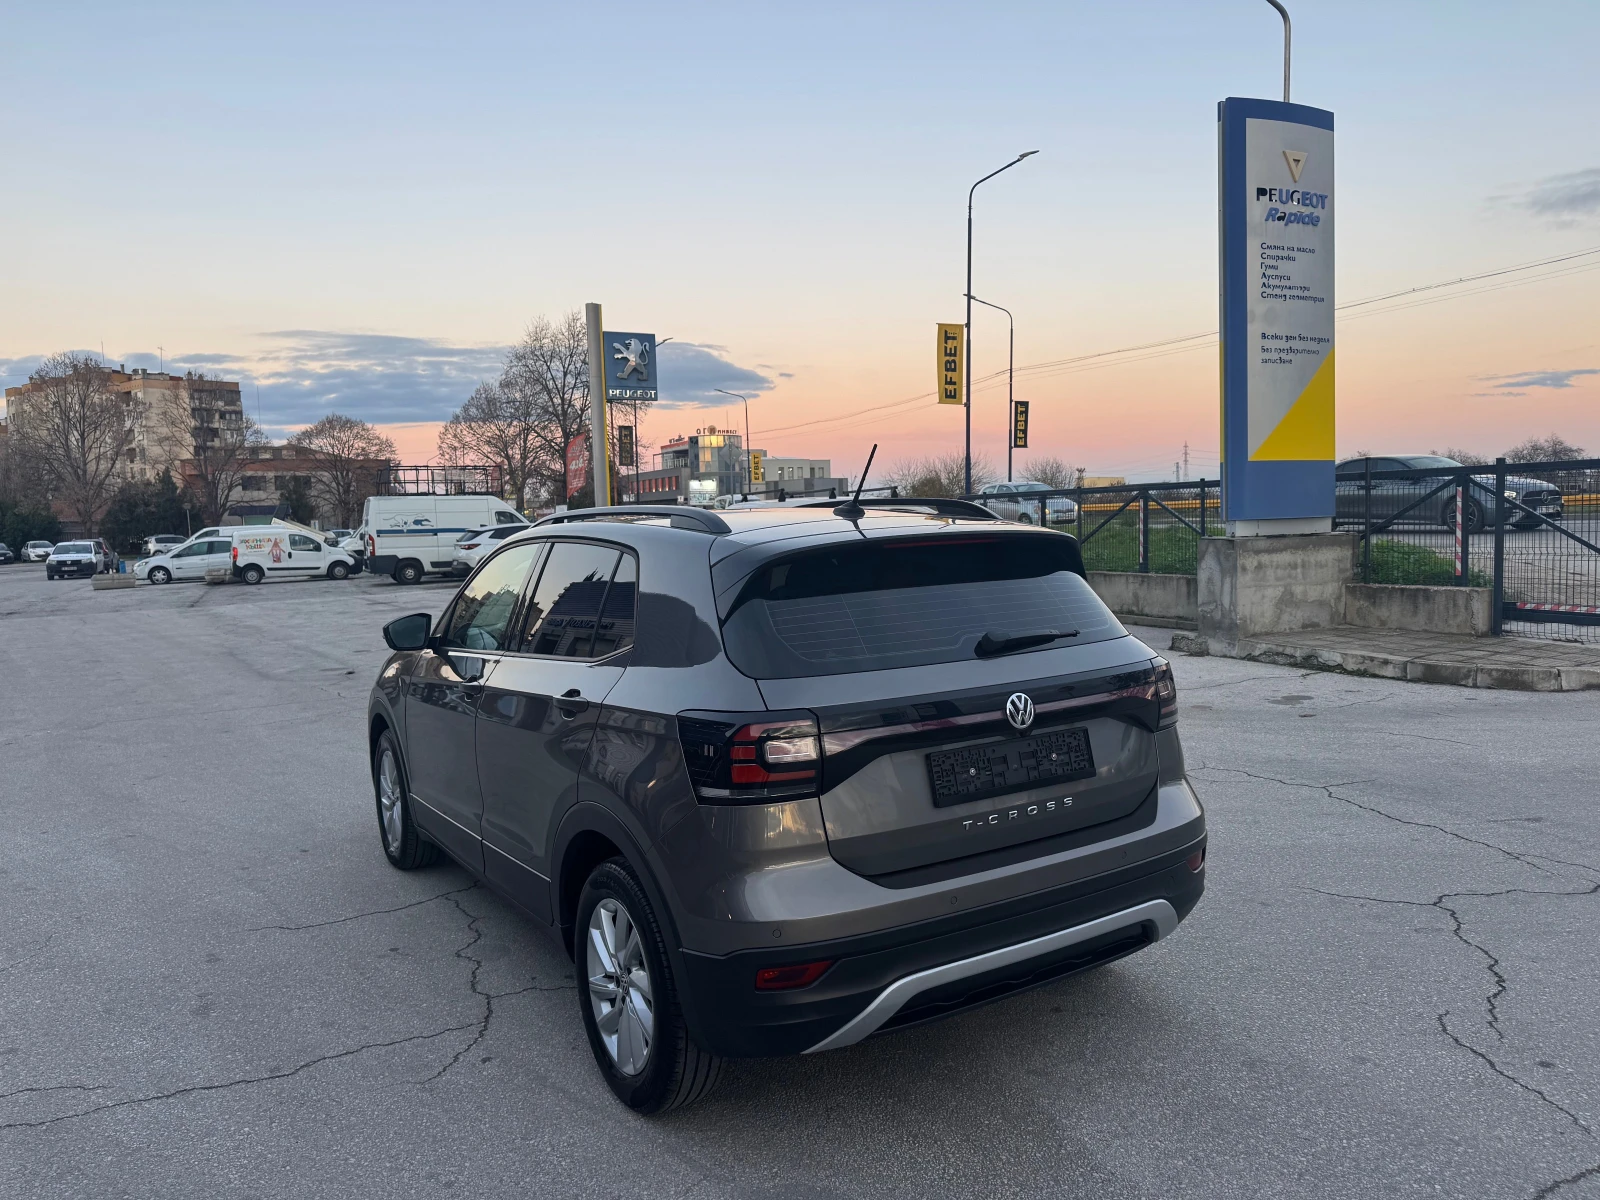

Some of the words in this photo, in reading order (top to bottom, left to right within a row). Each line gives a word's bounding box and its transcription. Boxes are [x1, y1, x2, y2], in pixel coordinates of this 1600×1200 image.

[1256, 187, 1328, 209] PEUGEOT
[1265, 207, 1320, 226] Rapide
[1261, 243, 1285, 251] Смяна
[1261, 252, 1296, 262] Спирачки
[1261, 262, 1278, 271] Гуми
[1261, 272, 1291, 282] Ауспуси
[1261, 282, 1310, 293] Акумулатори
[1261, 291, 1287, 301] Стенд
[1289, 295, 1324, 303] геометрия
[1310, 336, 1329, 344] неделя
[1274, 346, 1319, 355] предварително
[944, 330, 957, 399] EFBET
[609, 389, 656, 398] PEUGEOT
[1017, 404, 1025, 445] EFBET
[963, 797, 1072, 830] T-CROSS
